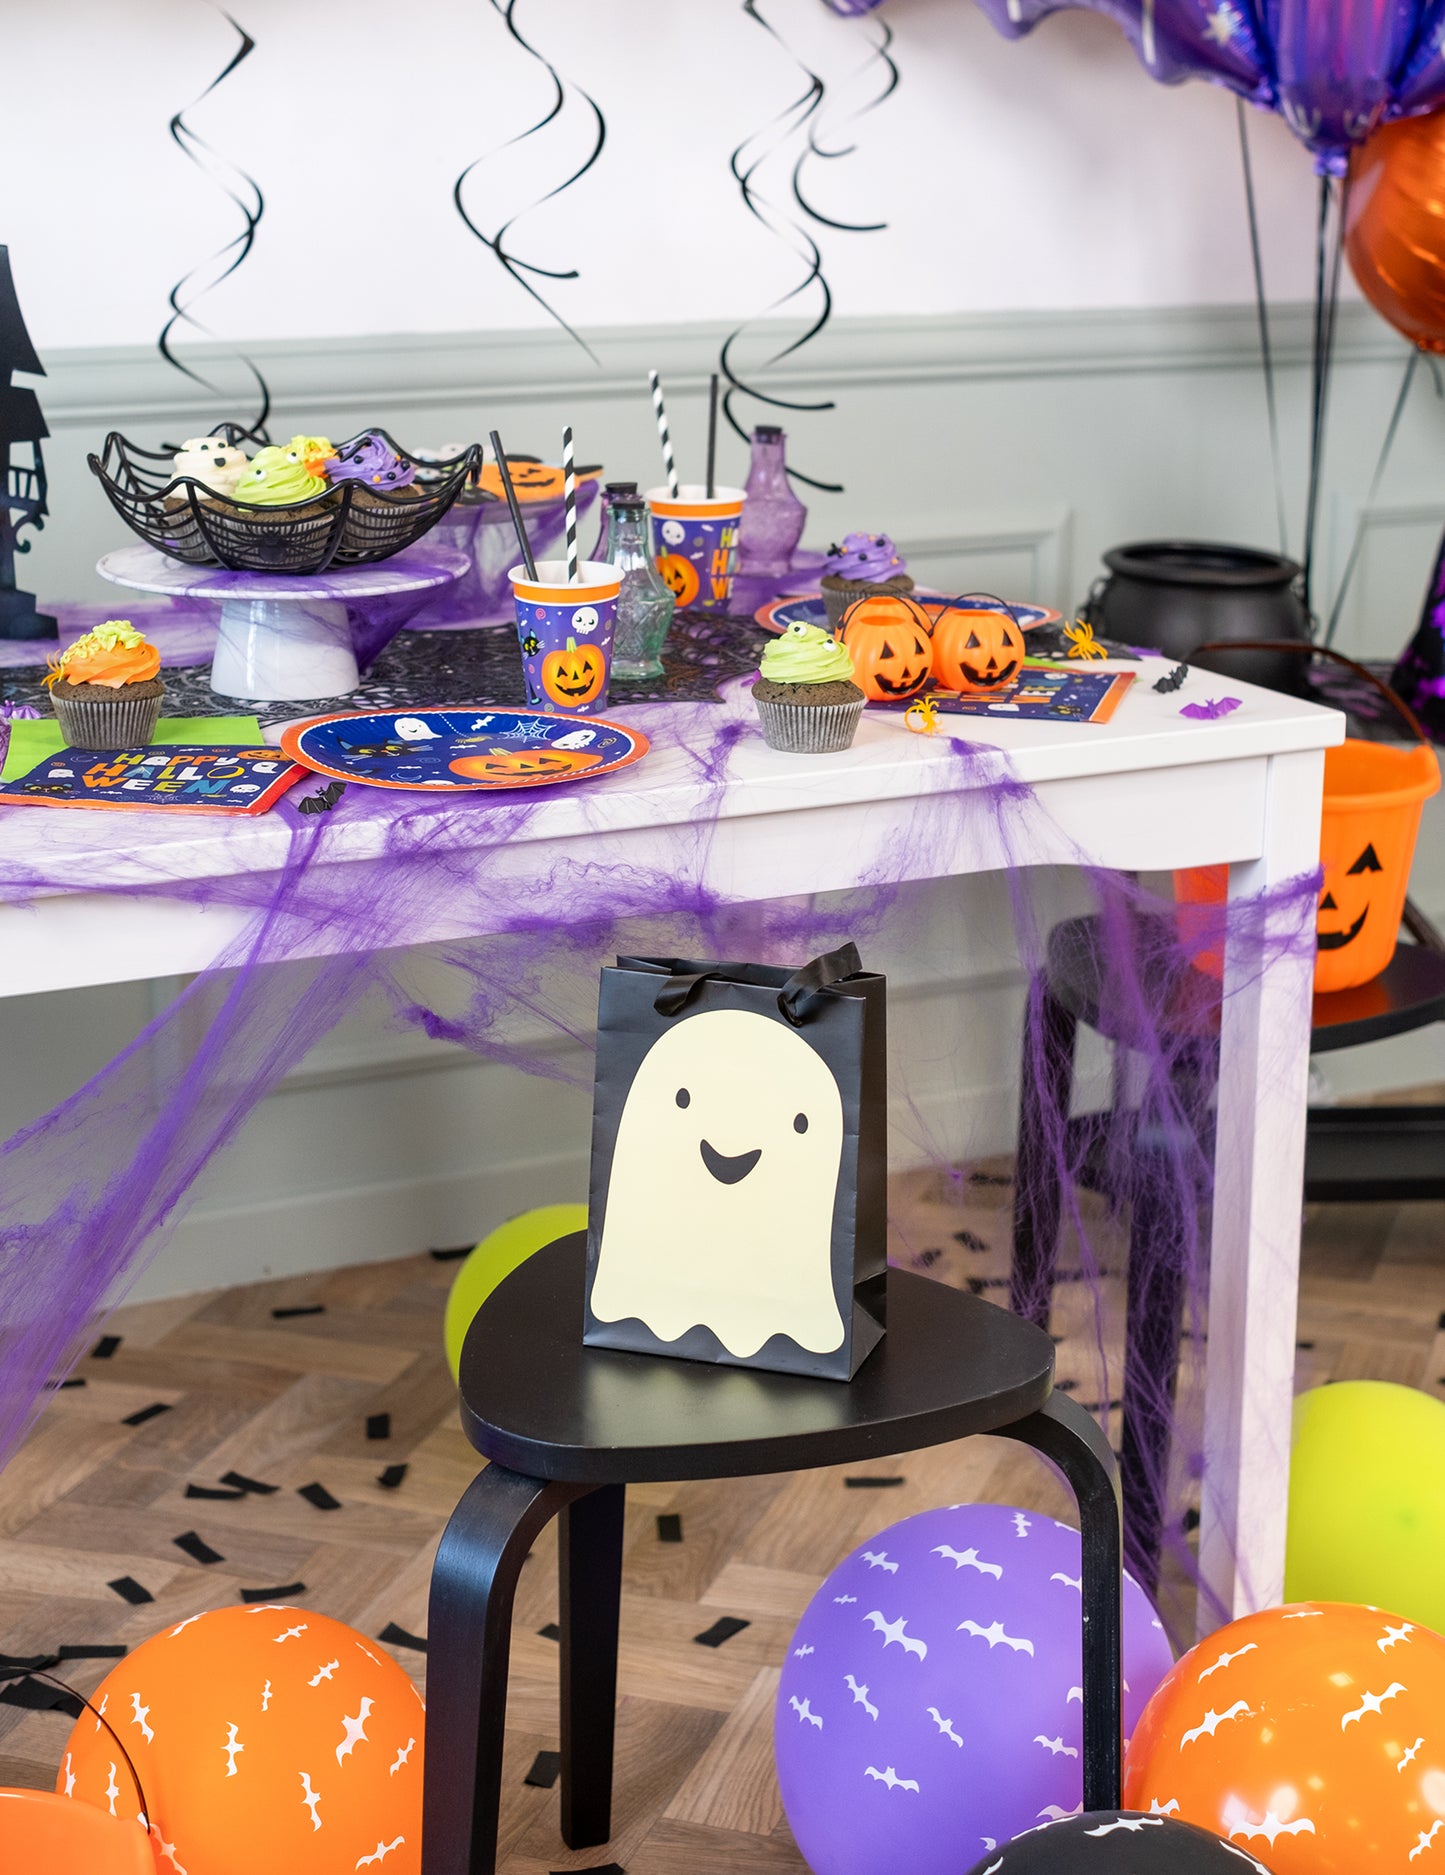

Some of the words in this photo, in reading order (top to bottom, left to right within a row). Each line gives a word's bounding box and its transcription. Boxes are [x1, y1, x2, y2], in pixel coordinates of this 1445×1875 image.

[112, 753, 239, 766] HAPPY
[84, 763, 245, 780] HALLO
[82, 775, 231, 793] WEEN
